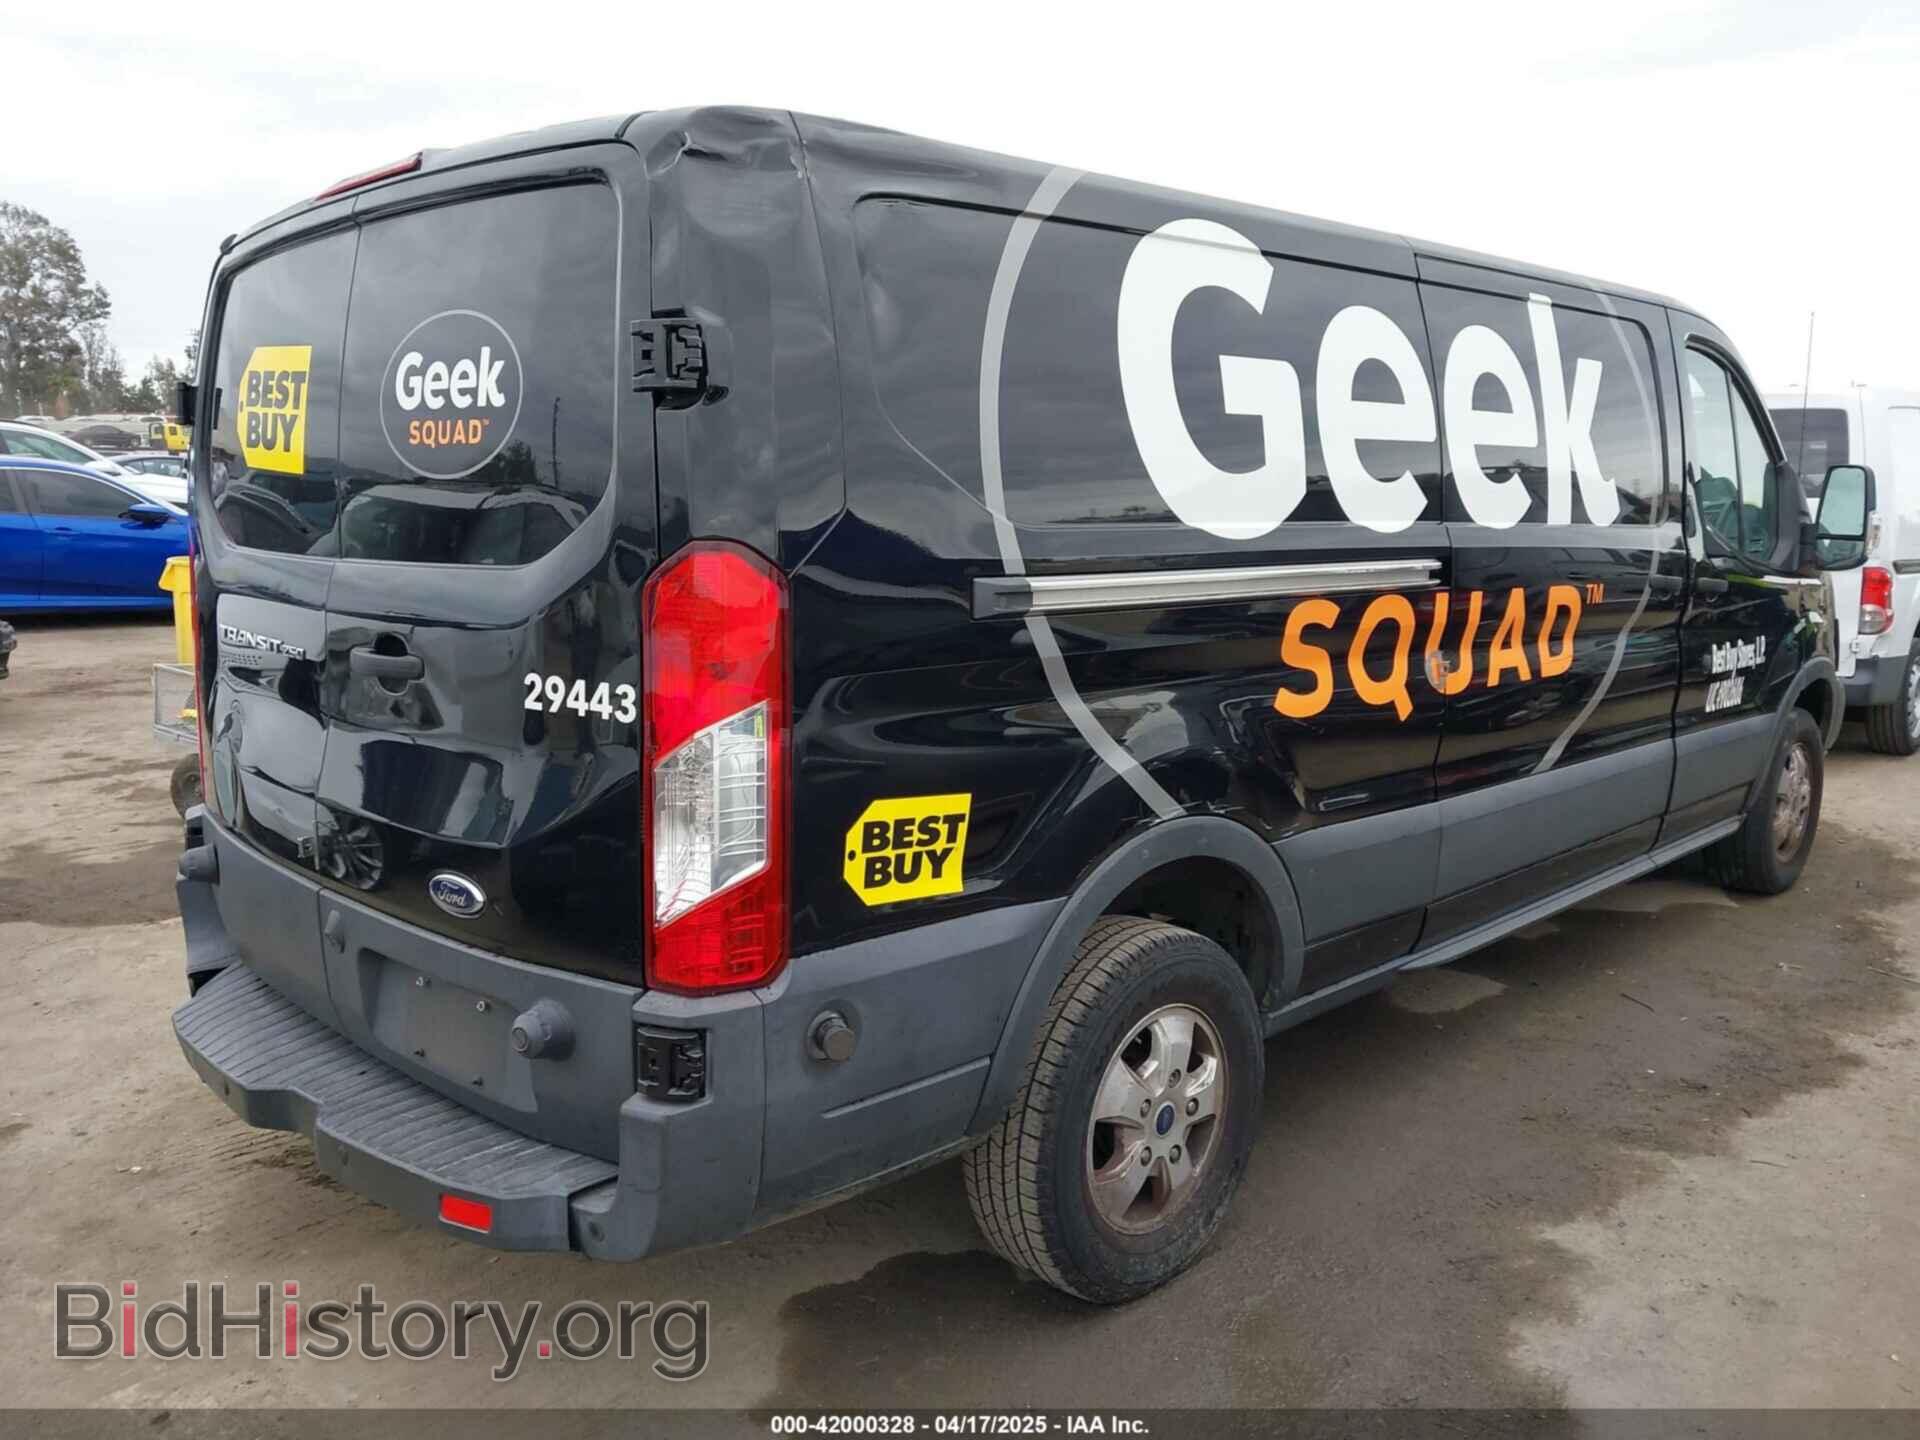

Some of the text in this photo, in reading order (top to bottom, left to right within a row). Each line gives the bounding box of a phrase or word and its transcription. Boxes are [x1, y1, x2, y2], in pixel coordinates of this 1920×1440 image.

[246, 371, 306, 408] BEST
[395, 346, 506, 411] Geek
[1117, 218, 1620, 539] Geek
[246, 412, 299, 453] BUY
[219, 623, 282, 654] TRANSIT
[1273, 585, 1582, 722] SQUAD
[524, 672, 637, 724] 29443
[861, 812, 967, 855] BEST
[863, 846, 956, 890] BUY
[438, 881, 466, 908] Ford
